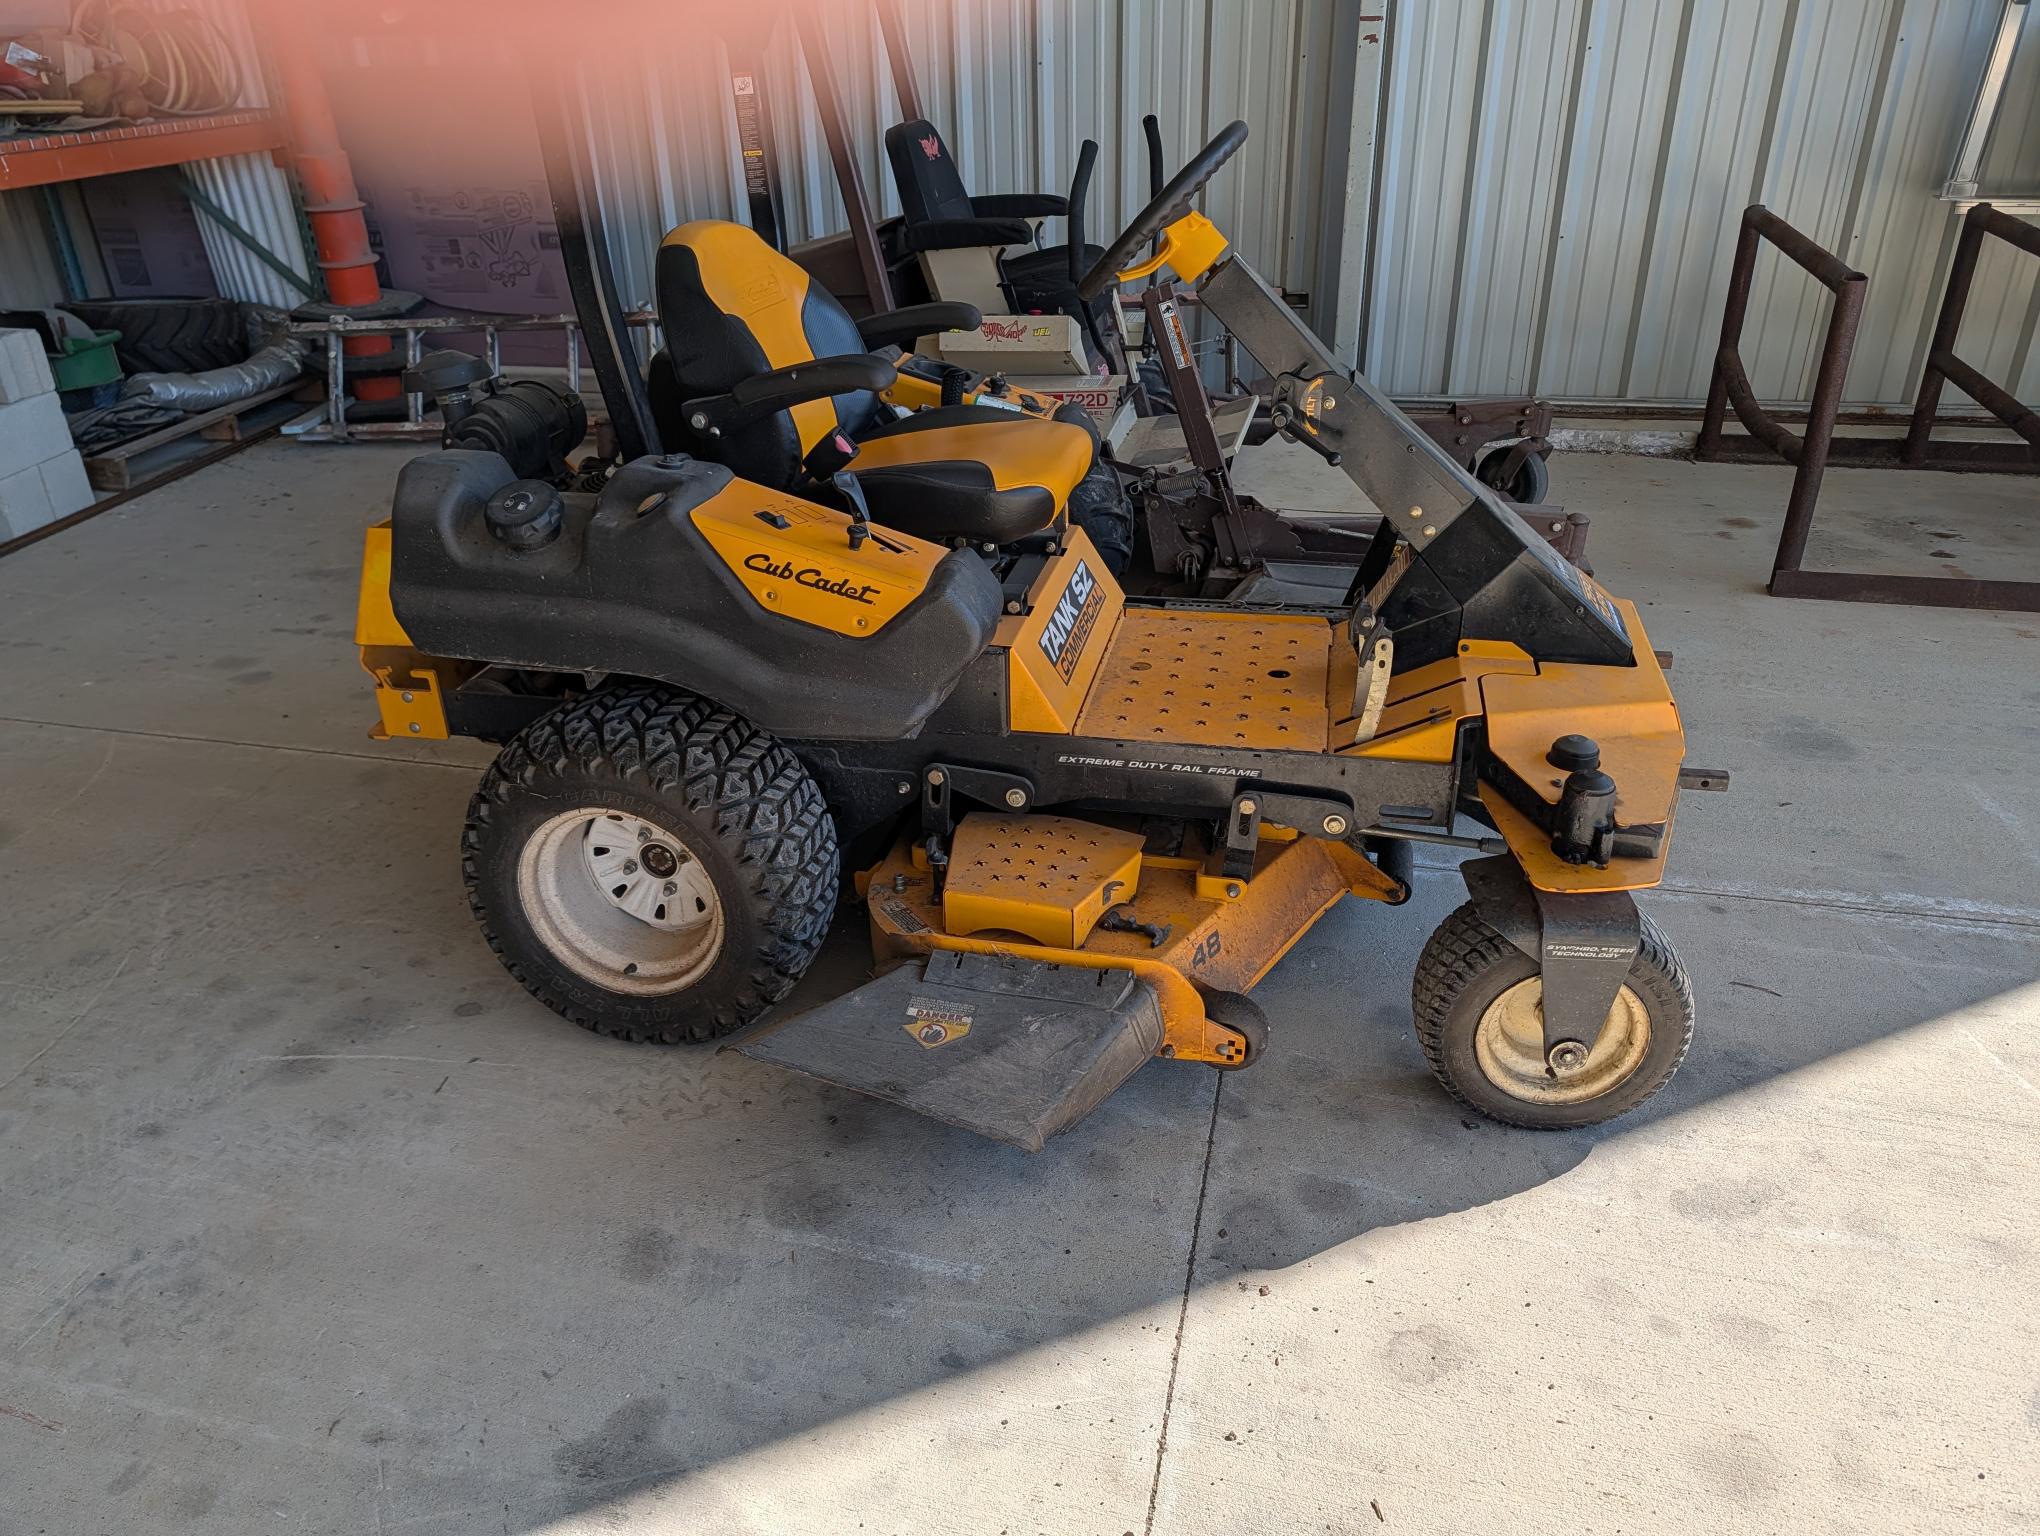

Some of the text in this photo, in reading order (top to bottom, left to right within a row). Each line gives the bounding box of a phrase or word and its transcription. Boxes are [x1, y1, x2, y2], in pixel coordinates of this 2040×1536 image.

[1066, 393, 1108, 407] 722D
[1306, 396, 1317, 417] TILT
[743, 553, 881, 605] Cub Cadet
[1040, 560, 1094, 663] TANK SZ
[1060, 589, 1104, 677] COMMERCIAL
[1058, 755, 1261, 778] EXTREME DUTY RAIL FRAME
[1192, 928, 1222, 969] 48
[1551, 950, 1621, 959] TECHNOLOGY
[915, 1009, 963, 1022] DANGER
